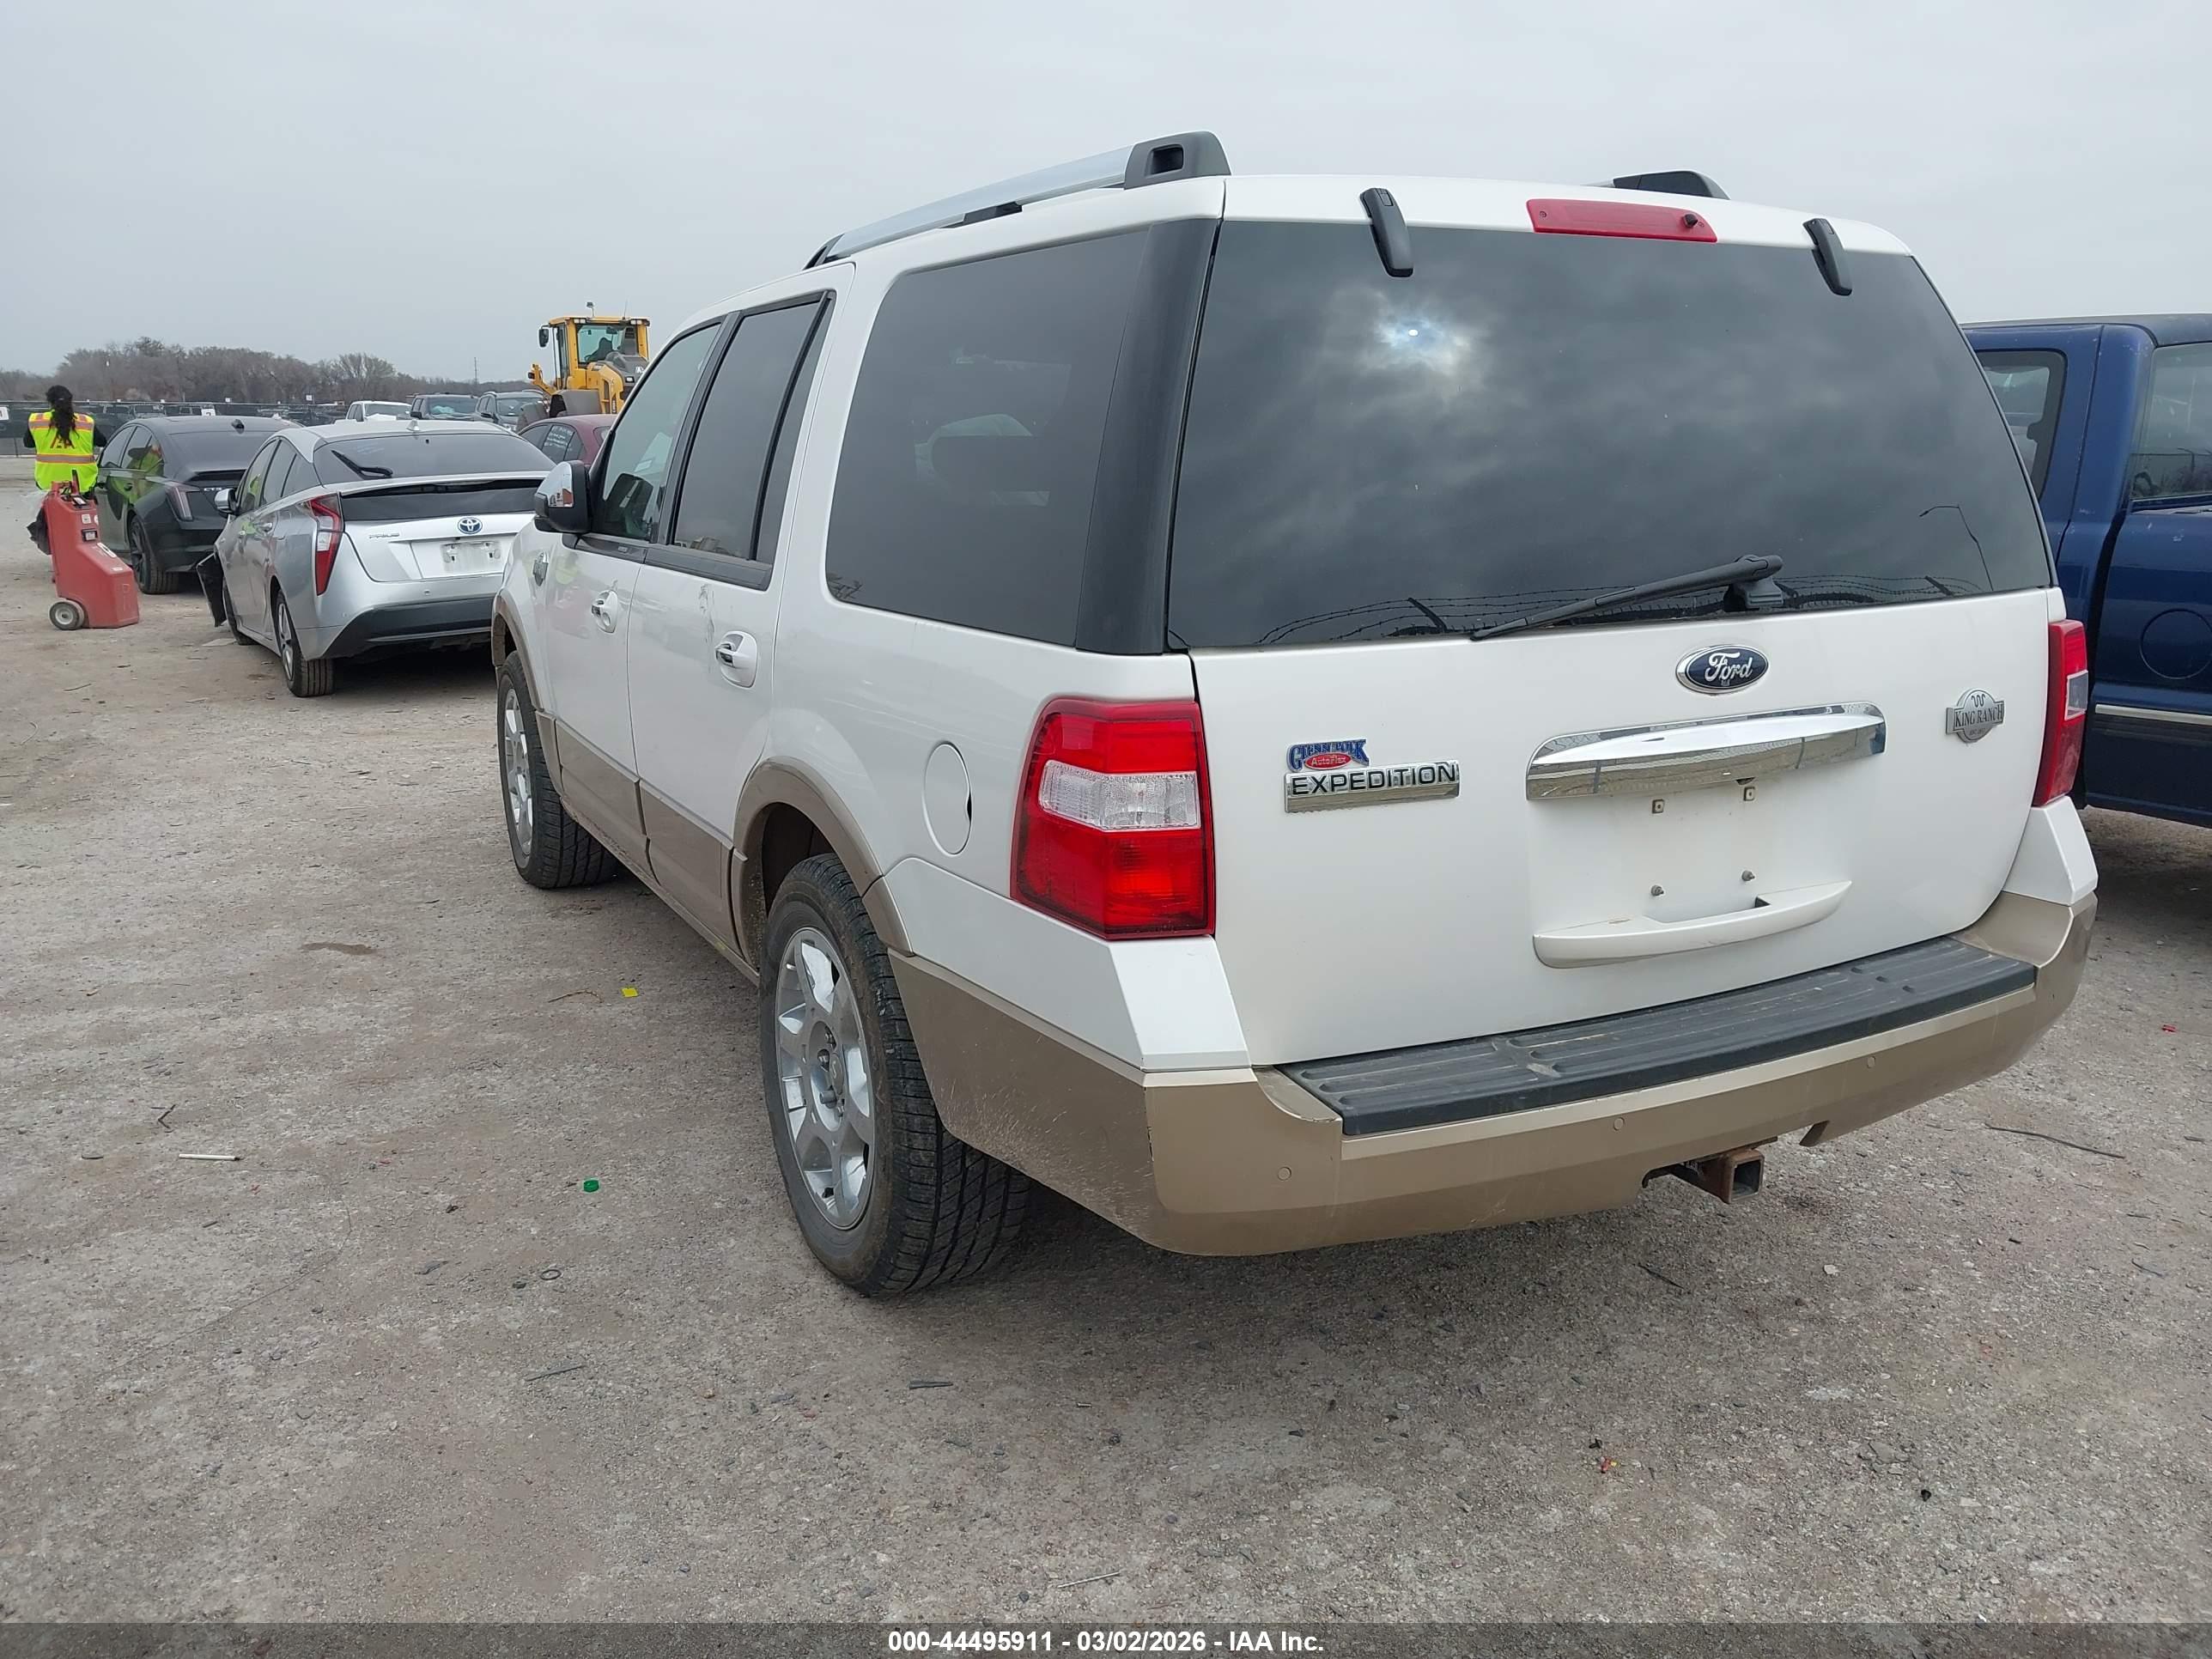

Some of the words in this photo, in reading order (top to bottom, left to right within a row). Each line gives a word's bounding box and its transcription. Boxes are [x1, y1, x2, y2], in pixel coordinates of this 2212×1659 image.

[1705, 652, 1753, 682] Ford
[1955, 711, 1975, 727] KING
[1977, 704, 2002, 723] RANCH
[1292, 763, 1456, 796] EXPEDITION
